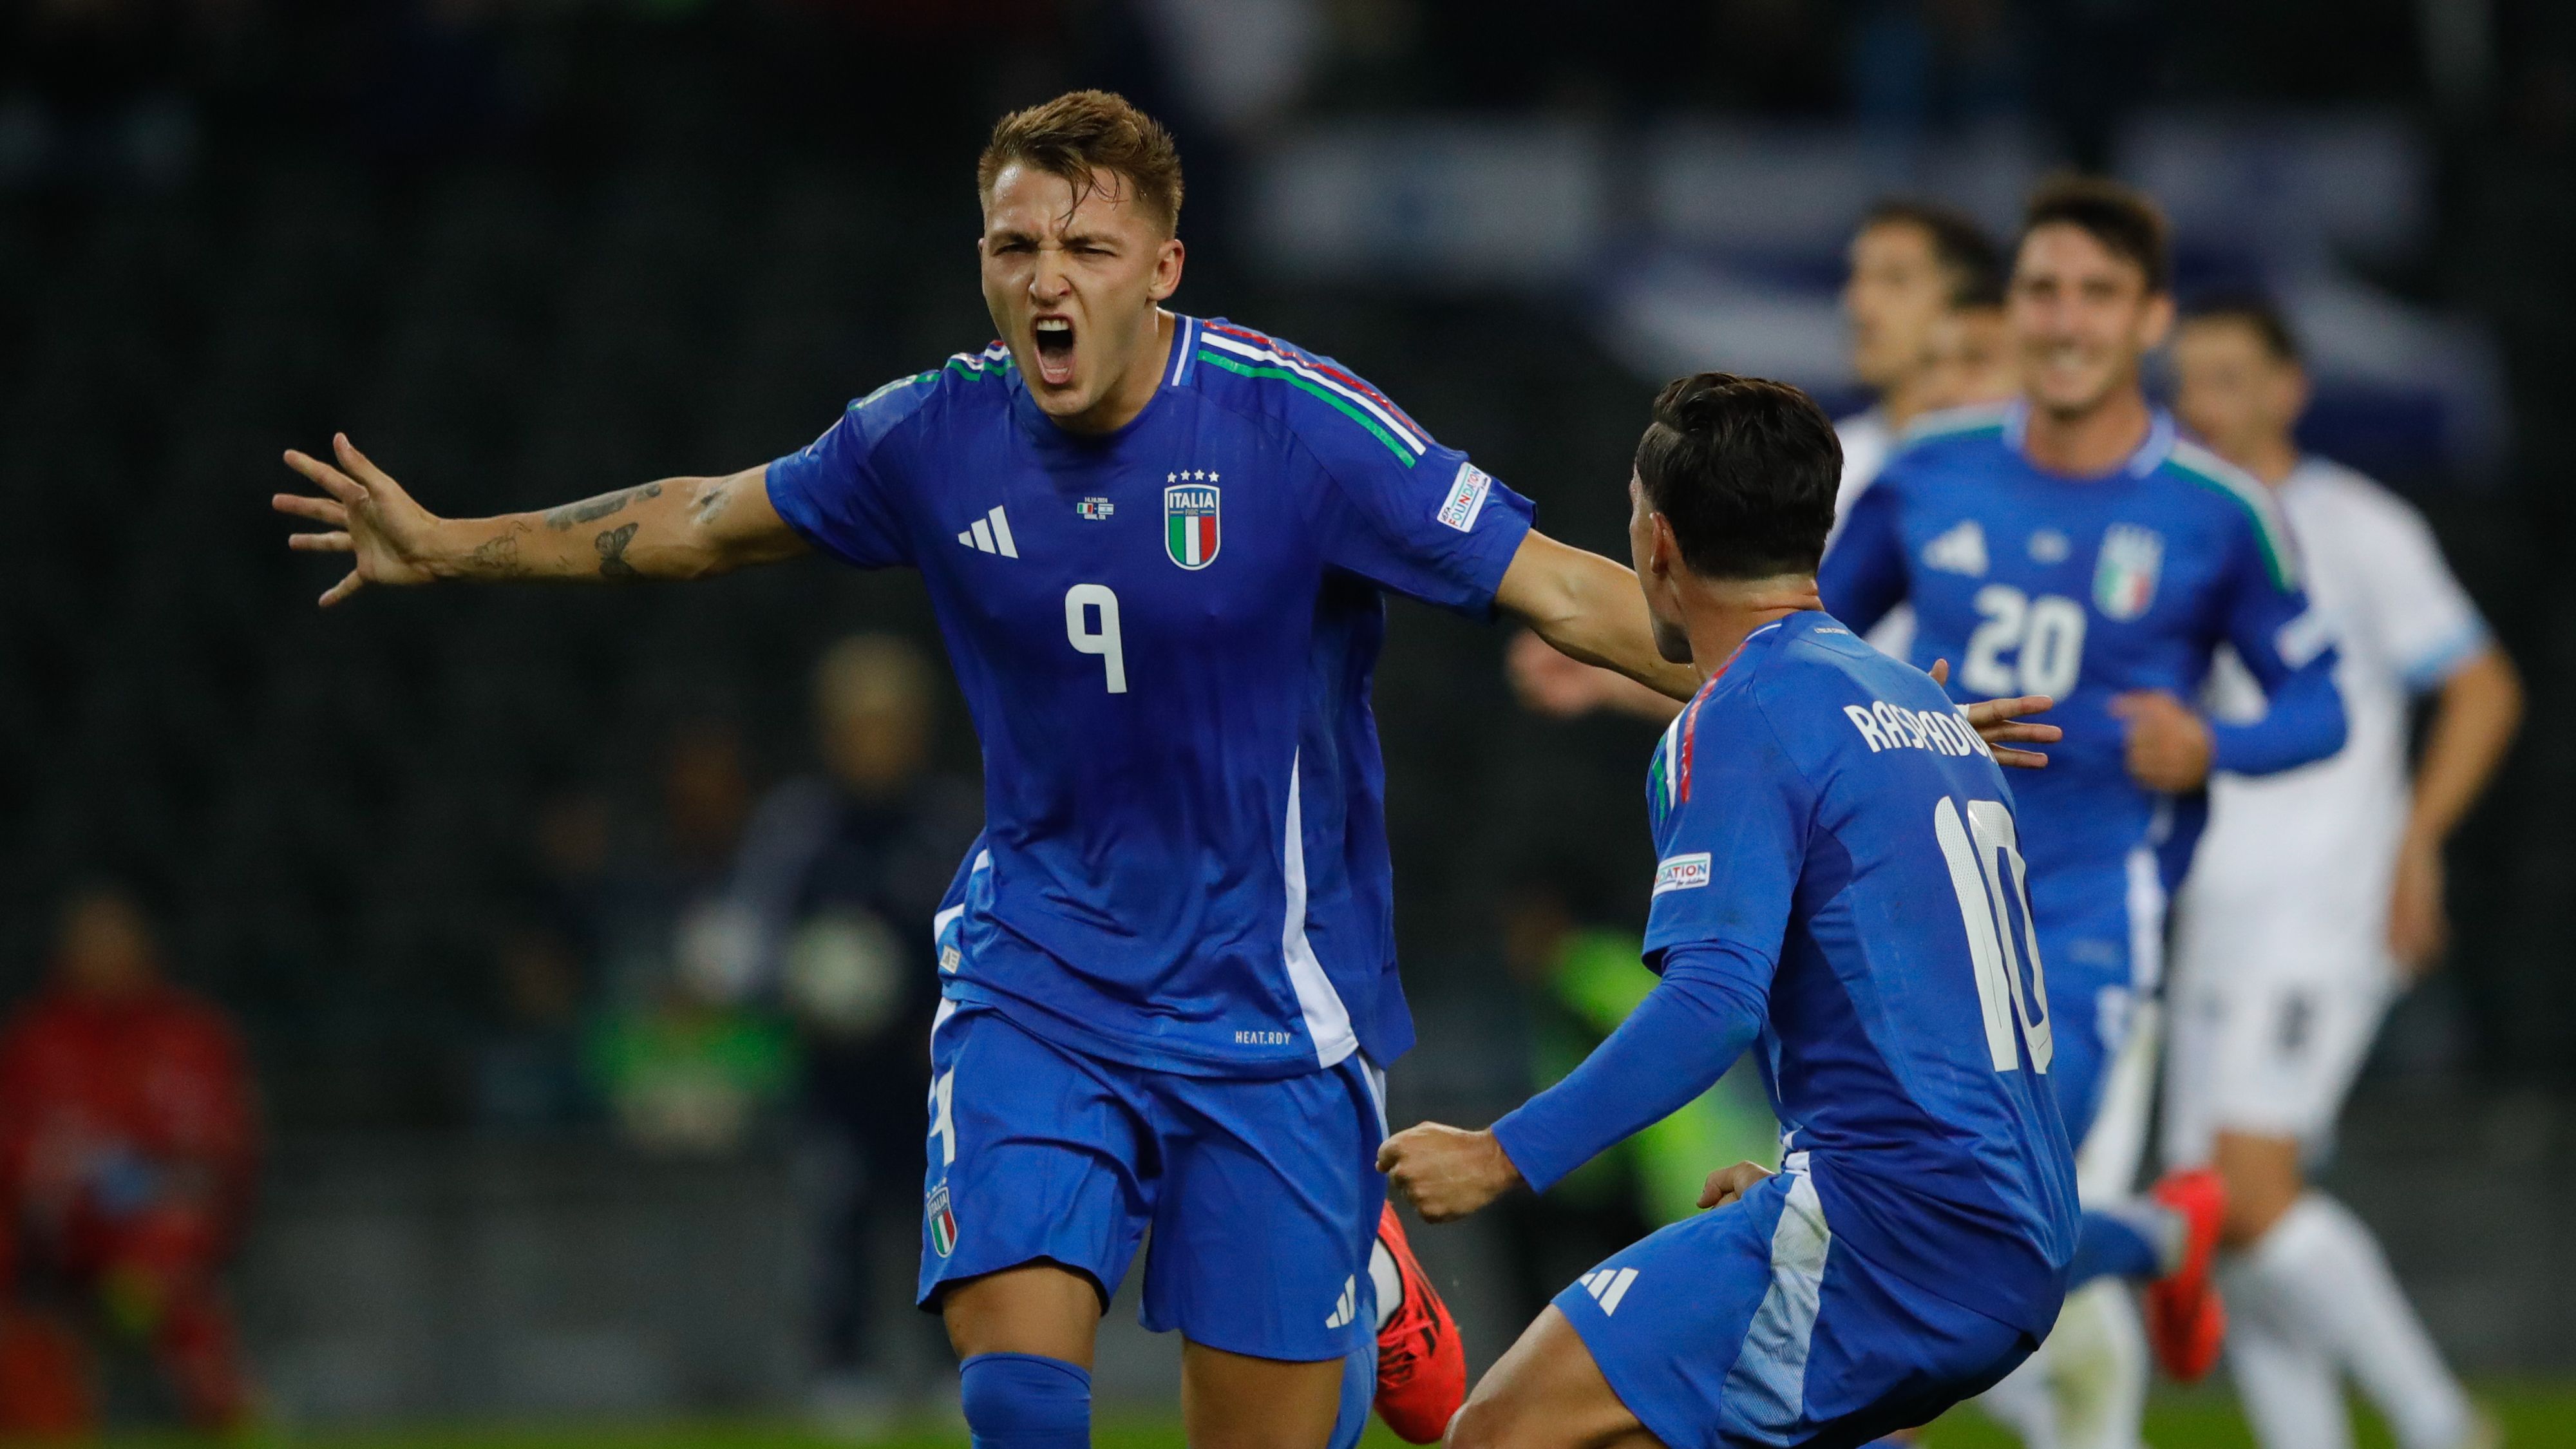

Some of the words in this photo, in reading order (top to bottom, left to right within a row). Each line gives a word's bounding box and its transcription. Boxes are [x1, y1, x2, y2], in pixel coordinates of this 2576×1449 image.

[1170, 492, 1215, 508] ITALIA
[1065, 583, 1128, 694] 9
[1960, 583, 2088, 703] 20
[1934, 795, 2053, 1074] 10
[1235, 1030, 1291, 1045] HEAT.RDY
